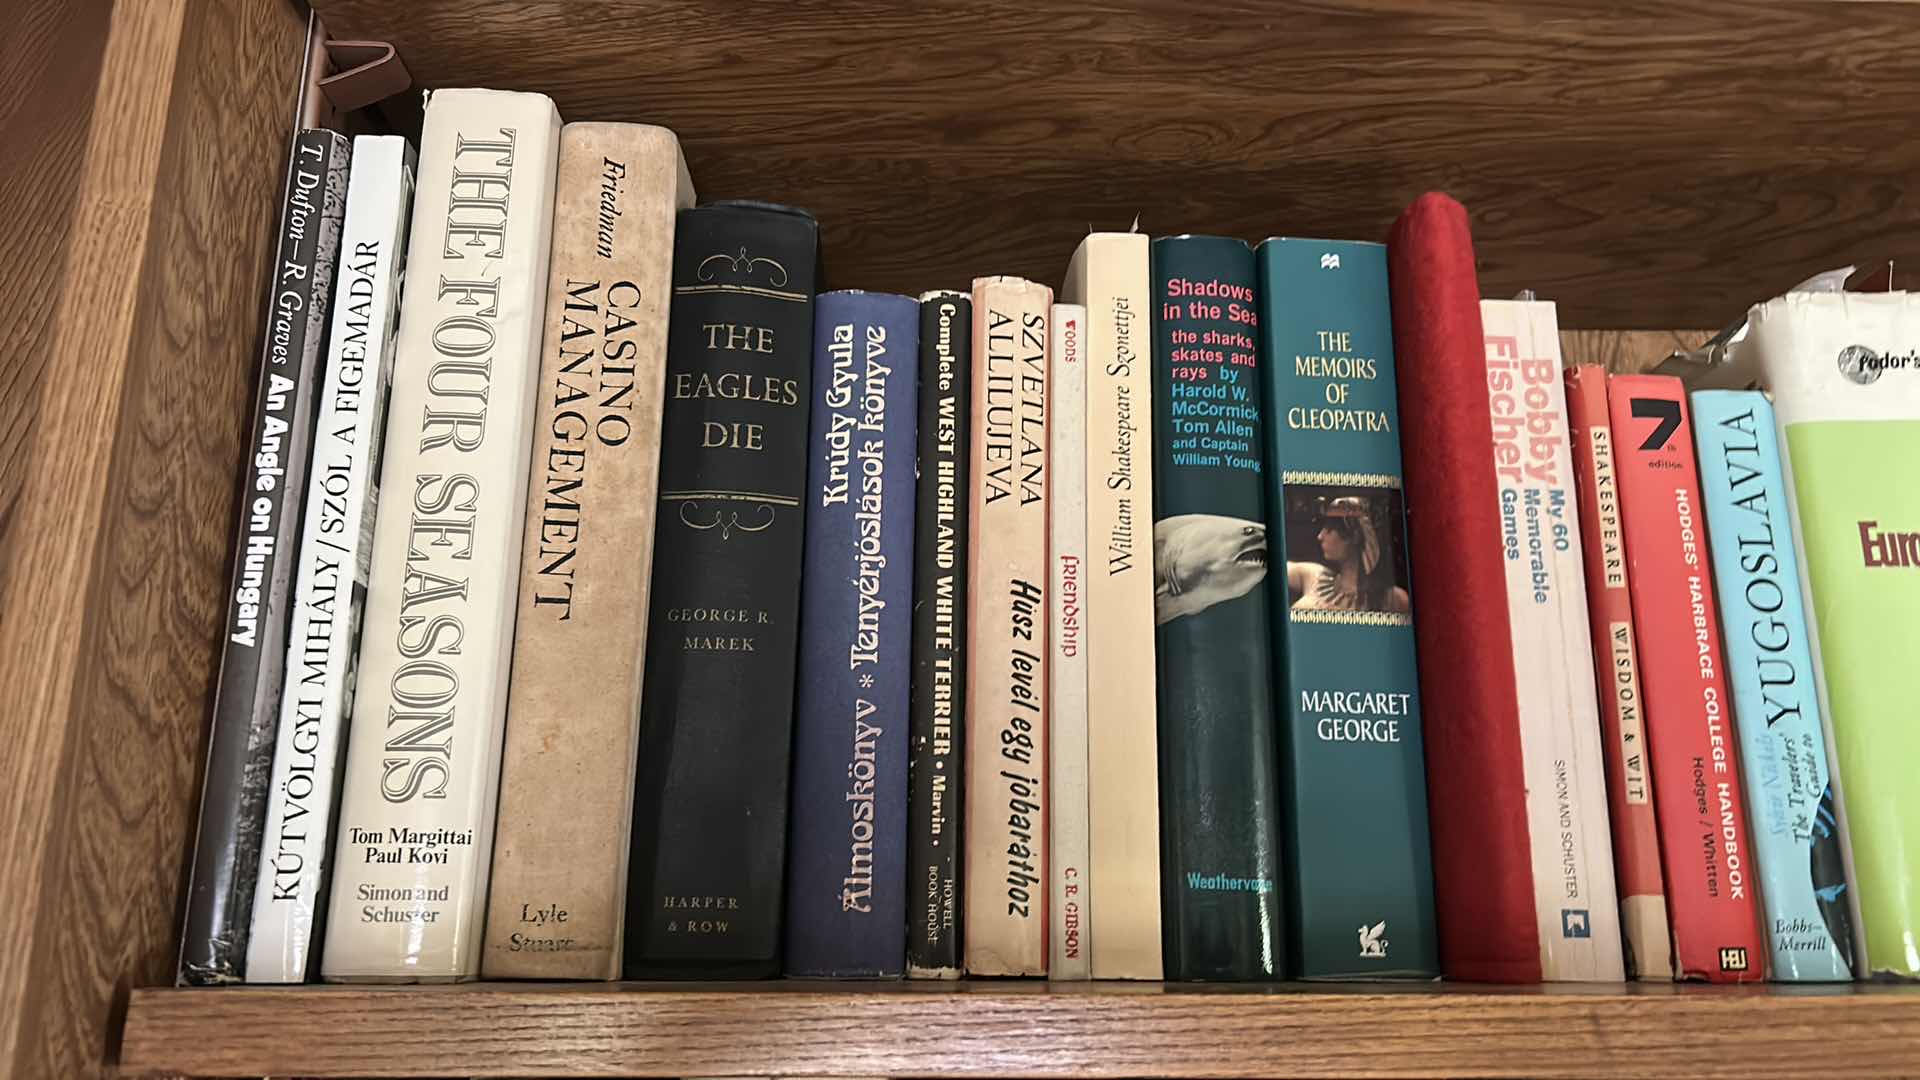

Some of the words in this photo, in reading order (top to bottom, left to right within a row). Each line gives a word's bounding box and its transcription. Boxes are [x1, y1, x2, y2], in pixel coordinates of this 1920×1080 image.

[300, 144, 323, 166] T.
[443, 127, 517, 260] THE
[597, 157, 626, 259] Friedman
[1163, 303, 1181, 320] in
[1190, 301, 1221, 319] the
[1228, 303, 1257, 326] Sea
[1167, 278, 1253, 302] Shadows
[272, 290, 302, 365] Graves
[335, 240, 380, 415] FIGEMADÁR
[703, 323, 774, 354] THE
[937, 303, 956, 391] Complete
[1106, 297, 1136, 377] Szonettjei
[1172, 329, 1197, 344] the
[1203, 330, 1255, 350] sharks,
[1318, 331, 1352, 353] THE
[419, 275, 501, 456] FOUR
[596, 280, 642, 447] CASINO
[826, 323, 858, 408] Gyula
[857, 325, 890, 431] könyve
[1172, 348, 1223, 362] skates
[1231, 352, 1255, 367] and
[1172, 367, 1207, 381] rays
[1220, 366, 1239, 383] by
[1295, 356, 1376, 380] MEMOIRS
[266, 374, 294, 411] An
[674, 373, 799, 406] EAGLES
[985, 309, 1014, 506] ALLILUJEVA
[1020, 313, 1045, 508] SZVETLANA
[1172, 384, 1226, 398] Harold
[1232, 386, 1249, 401] W.
[1326, 383, 1350, 405] OF
[1486, 336, 1525, 484] Fischer
[332, 425, 356, 445] A
[702, 422, 764, 450] DIE
[936, 396, 956, 456] WEST
[1107, 385, 1137, 490] Shakespeare
[1172, 419, 1209, 433] Tom
[1216, 420, 1253, 438] Allen
[1288, 407, 1390, 432] CLEOPATRA
[1521, 357, 1561, 485] Bobby
[255, 415, 289, 492] Angle
[534, 279, 600, 620] MANAGEMENT
[823, 411, 857, 507] Krúdy
[1172, 438, 1196, 449] and
[1201, 437, 1248, 452] Captain
[1172, 454, 1220, 466] William
[1225, 455, 1261, 472] Young
[1648, 460, 1684, 470] edition
[250, 497, 272, 532] on
[320, 455, 353, 533] SZÓL
[935, 461, 955, 569] HIGHLAND
[1547, 489, 1565, 518] My
[1593, 431, 1623, 585] SHAKESPEARE
[1109, 497, 1132, 576] William
[1500, 488, 1519, 560] Games
[1524, 488, 1550, 604] Memorable
[1551, 522, 1569, 551] 60
[850, 438, 887, 670] Tenyérjóslások
[1719, 408, 1800, 728] YUGOSLAVIA
[231, 536, 274, 648] Hungary
[667, 608, 749, 623] GEORGE
[757, 611, 775, 624] R.
[934, 573, 953, 652] WHITE
[1010, 579, 1042, 640] Húsz
[301, 558, 338, 687] MIHÁLY
[380, 473, 480, 803] SEASONS
[684, 636, 754, 651] MAREK
[1010, 649, 1041, 712] levél
[1302, 690, 1410, 716] MARGARET
[1675, 488, 1698, 570] HODGES'
[1687, 576, 1714, 679] HARBRACE
[1703, 686, 1727, 773] COLLEGE
[1717, 782, 1744, 900] HANDBOOK
[933, 655, 952, 756] TERRIER
[1317, 718, 1400, 742] GEORGE
[1614, 627, 1636, 720] WISDOM
[1627, 754, 1643, 800] WIT
[1001, 718, 1034, 765] egy
[1802, 734, 1813, 748] to
[272, 697, 322, 902] KÚTVÖLGYI
[1554, 760, 1568, 800] SIMON
[1803, 751, 1821, 799] Guide
[839, 698, 882, 913] Álmoskönyv
[931, 775, 946, 836] Marvin
[1559, 804, 1570, 828] AND
[1693, 757, 1708, 815] Hodges
[1704, 832, 1718, 897] Whitten
[1793, 813, 1811, 844] The
[350, 828, 383, 845] Tom
[388, 827, 472, 848] Margittai
[365, 848, 402, 864] Paul
[408, 848, 448, 865] Kovi
[1000, 770, 1041, 917] jóbaráthoz
[928, 865, 938, 898] BOOK
[1561, 832, 1577, 898] SCHUSTER
[357, 884, 411, 901] Simon
[416, 886, 448, 901] and
[361, 906, 439, 923] Schuster
[521, 904, 568, 924] Lyle
[664, 896, 739, 909] HARPER
[943, 880, 953, 929] HOWELL
[687, 920, 728, 933] ROW
[928, 904, 938, 945] HOUSE
[1065, 903, 1079, 959] GIBSON
[1779, 937, 1825, 951] Merrill
